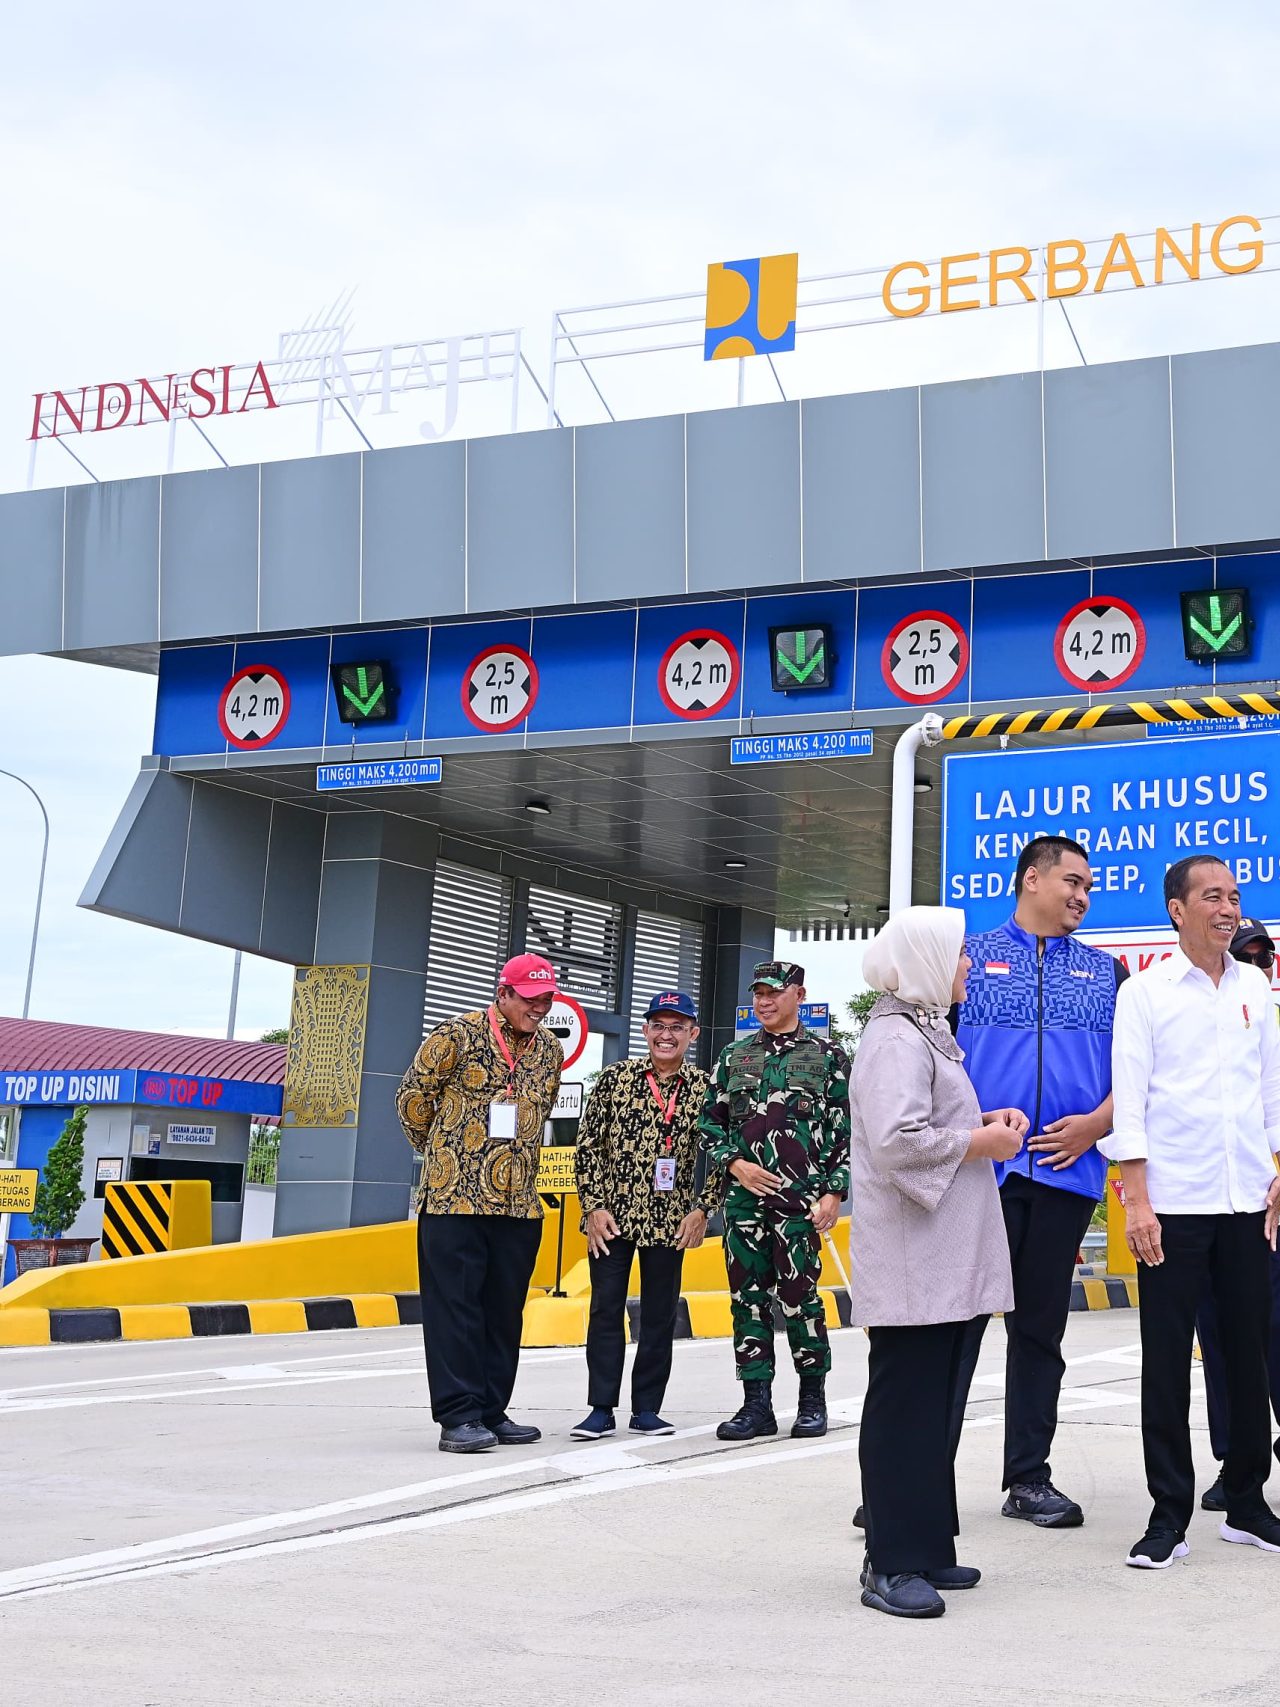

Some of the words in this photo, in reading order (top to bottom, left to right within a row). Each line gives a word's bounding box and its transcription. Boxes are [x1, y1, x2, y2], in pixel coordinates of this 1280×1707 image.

[882, 214, 1265, 319] GERBANG
[908, 628, 941, 659] 2,5
[1069, 629, 1104, 661] 4,2
[1112, 631, 1131, 654] m
[486, 661, 515, 690] 2,5
[671, 661, 702, 691] 4,2
[709, 663, 727, 684] m
[915, 663, 935, 686] m
[231, 694, 259, 722] 4,2
[263, 695, 279, 716] m
[490, 694, 508, 715] m
[734, 740, 774, 755] TINGGI
[778, 737, 808, 752] MAKS
[812, 734, 846, 749] 4.200
[850, 734, 871, 747] mm
[320, 767, 355, 782] TINGGI
[358, 765, 386, 779] MAKS
[974, 784, 1092, 822] LAJUR
[1112, 771, 1269, 812] KHUSUS
[974, 823, 1156, 860] KENRAAN
[1175, 817, 1268, 848] KECIL,
[951, 873, 1017, 900] SEDA
[1090, 865, 1146, 895] EEP,
[528, 968, 552, 980] adhi
[543, 1015, 574, 1026] RBANG
[797, 1006, 810, 1018] Rp)
[5, 1076, 38, 1101] TOP
[41, 1075, 65, 1101] UP
[67, 1075, 120, 1101] DISINI
[168, 1077, 198, 1104] TOP
[202, 1081, 223, 1106] UP
[538, 1165, 550, 1174] DA
[552, 1164, 575, 1175] PETU
[543, 1152, 577, 1162] HATI-HA
[536, 1177, 577, 1188] ENYEBER
